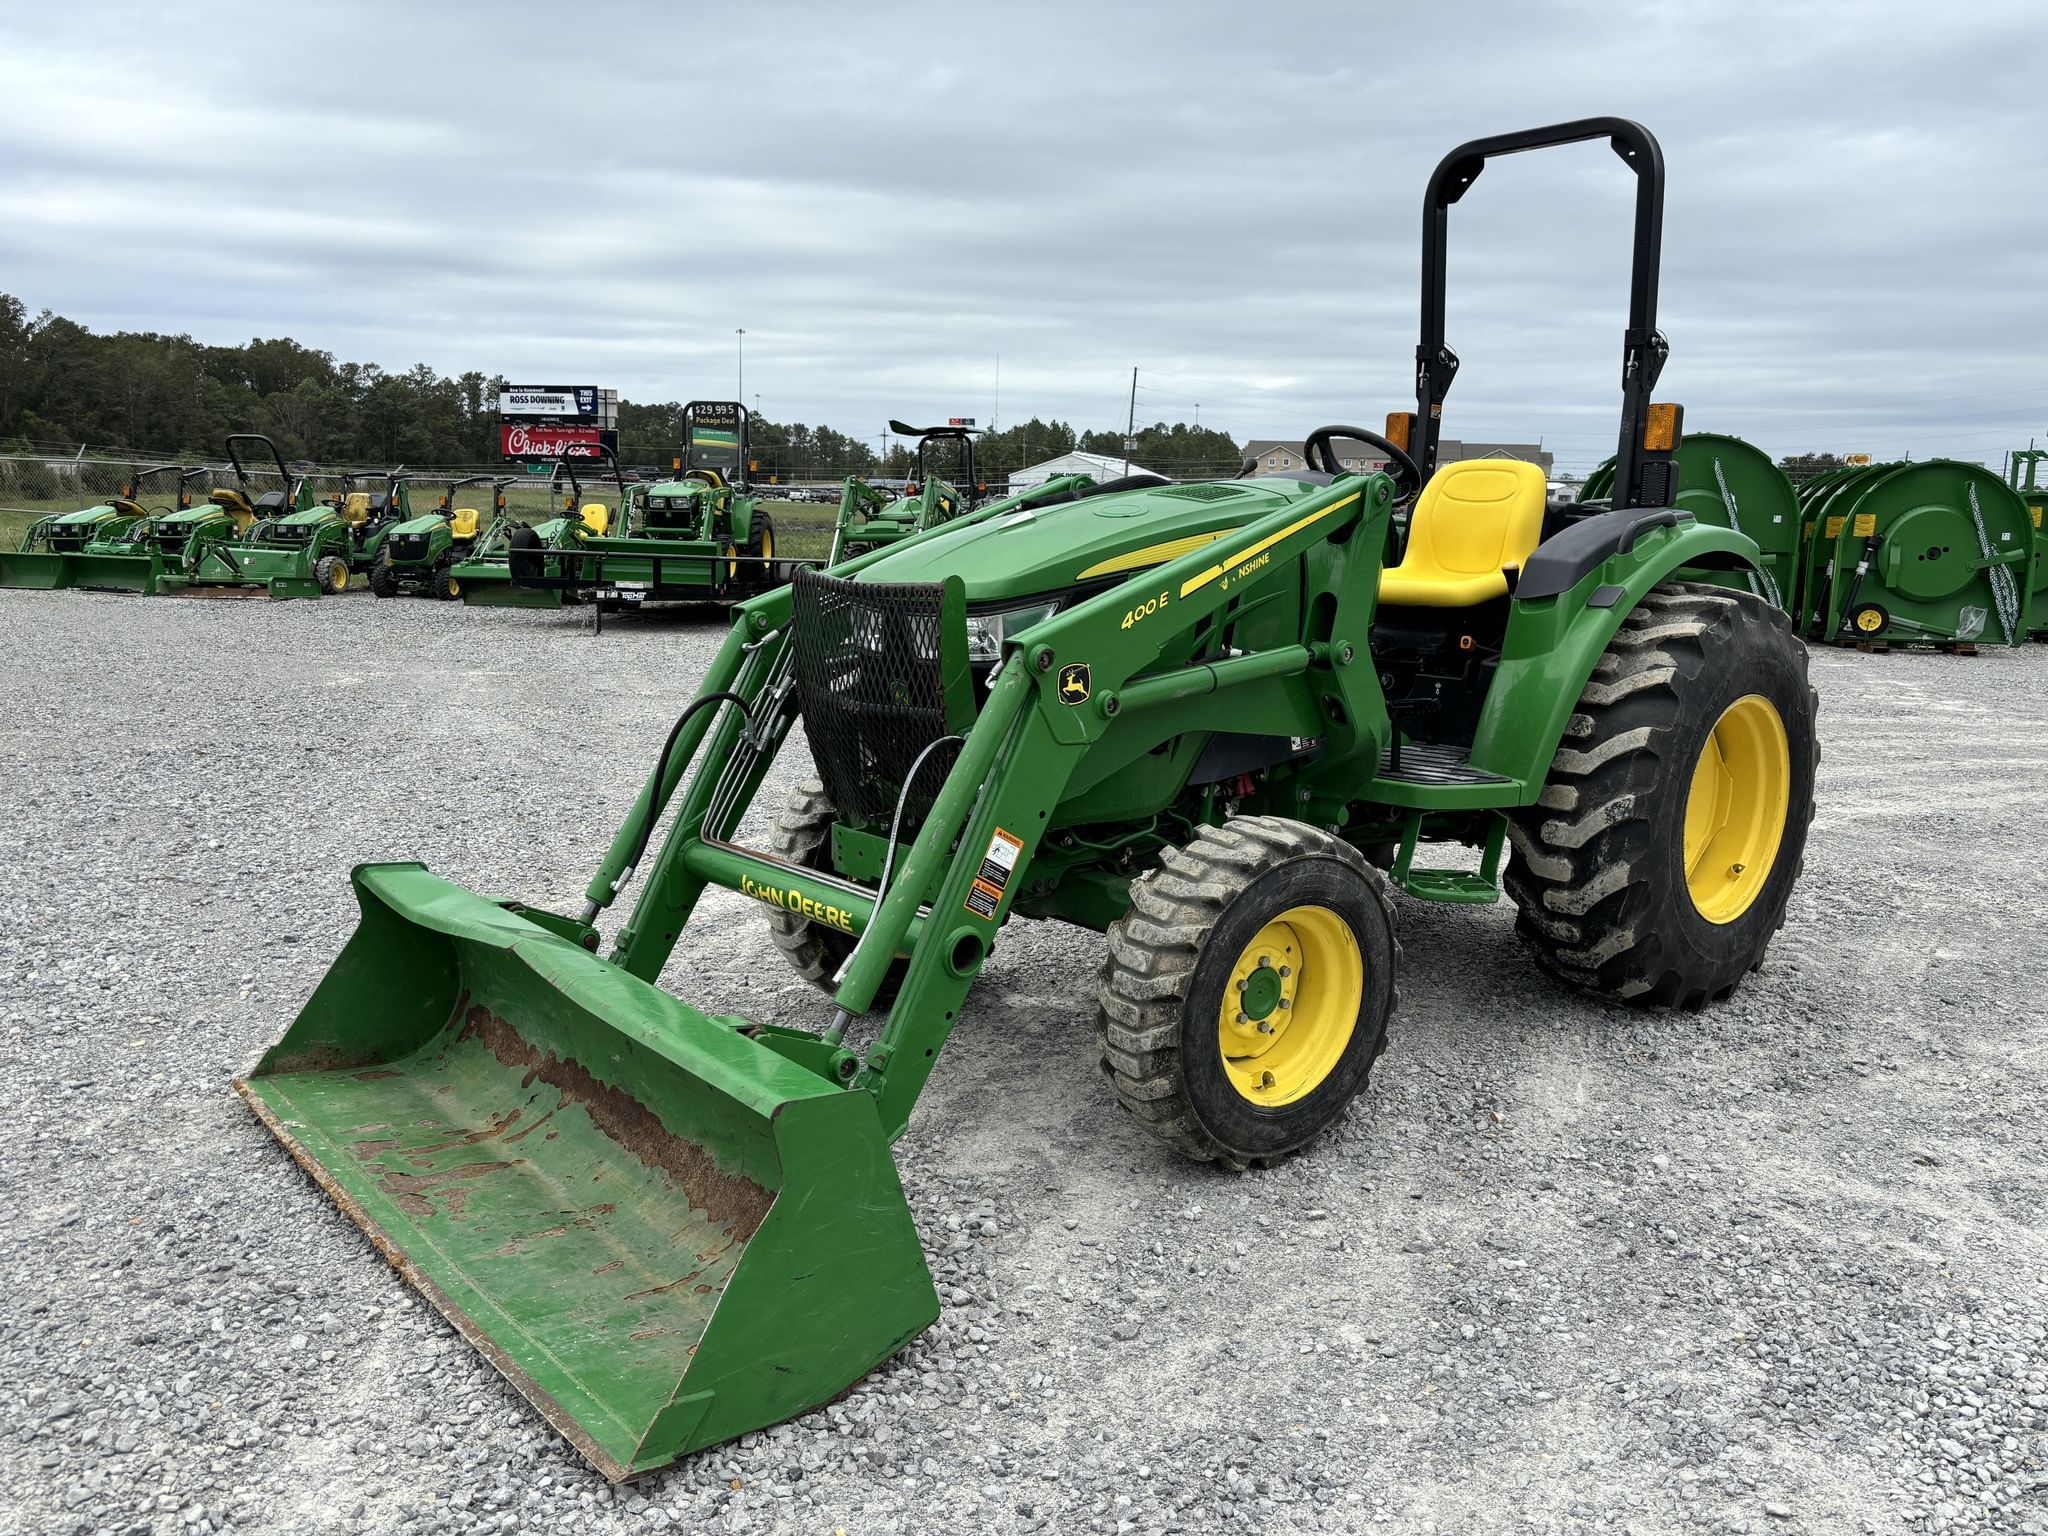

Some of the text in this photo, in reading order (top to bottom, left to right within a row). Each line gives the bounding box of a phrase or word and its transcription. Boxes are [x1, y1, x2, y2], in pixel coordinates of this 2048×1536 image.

[510, 396, 565, 404] ROSS DOWNING
[695, 405, 734, 416] $29,995
[696, 417, 720, 425] Package
[738, 874, 854, 932] JOHN DEERE
